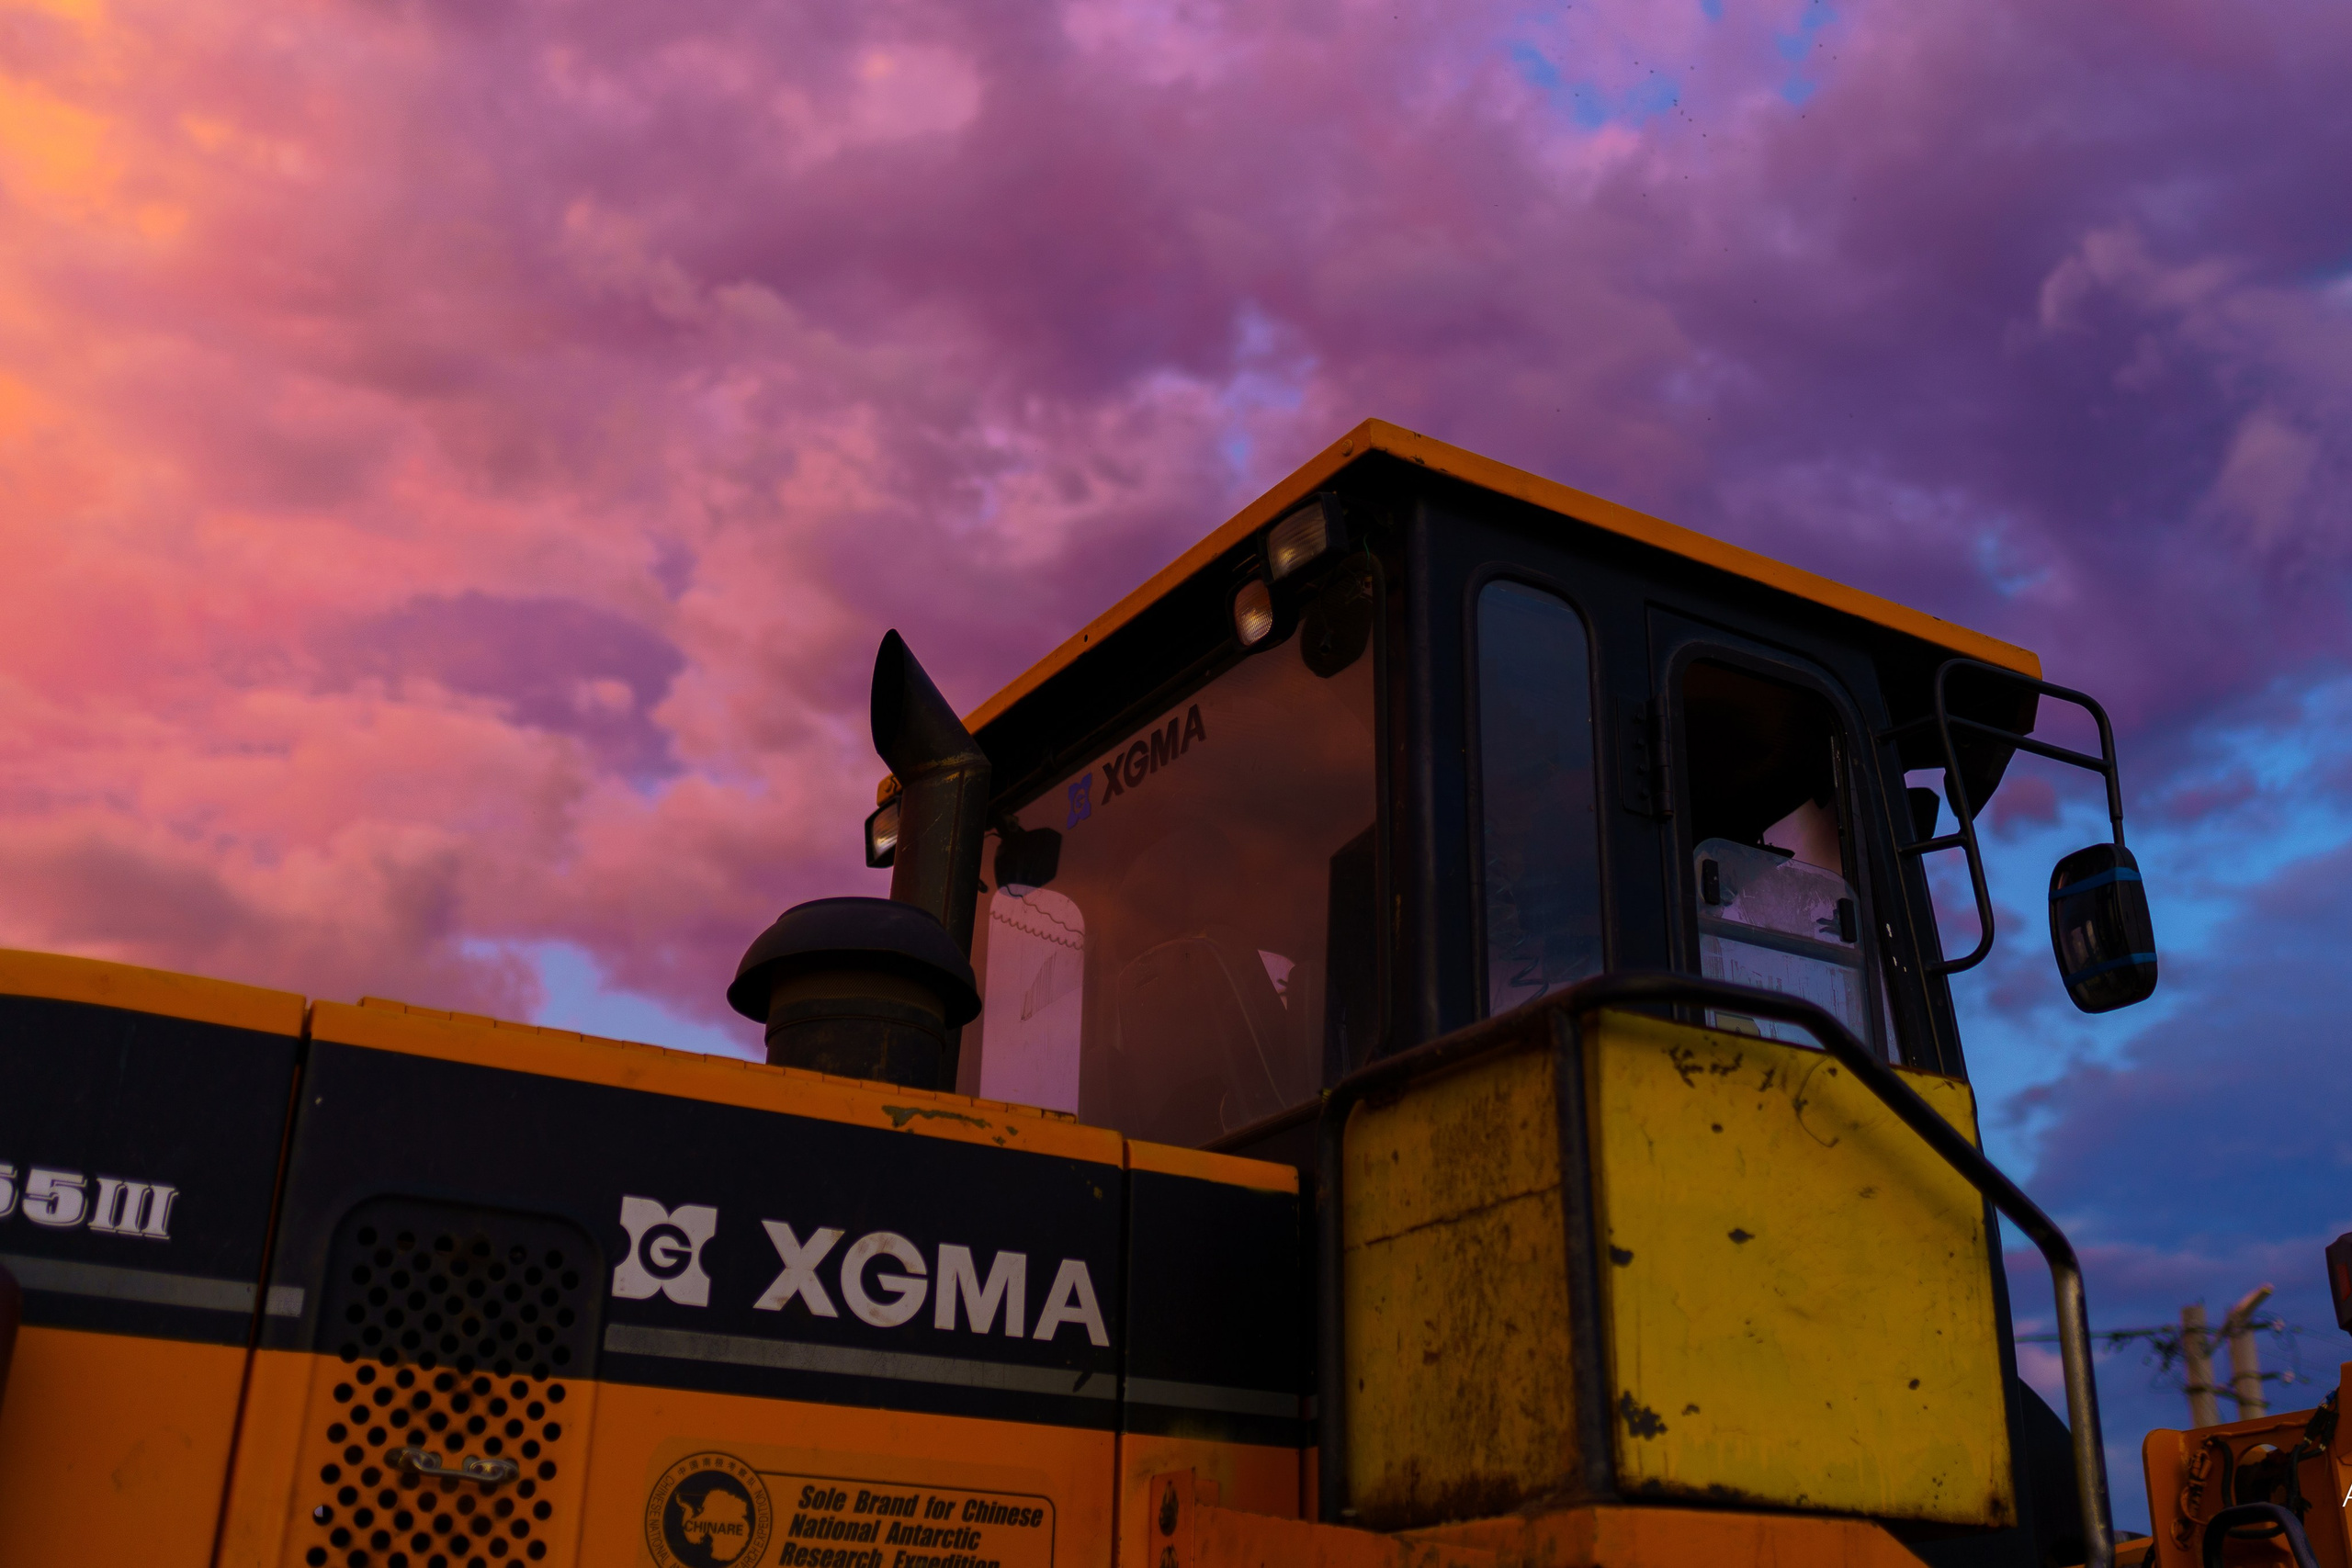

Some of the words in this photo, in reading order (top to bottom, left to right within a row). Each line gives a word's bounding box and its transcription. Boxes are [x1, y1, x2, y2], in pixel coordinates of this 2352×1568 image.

[1102, 704, 1206, 806] XGMA
[0, 1164, 179, 1240] 5III
[752, 1218, 1110, 1348] XGMA
[649, 1475, 675, 1517] CHINESE
[753, 1489, 769, 1549] EXPEDITION
[797, 1484, 847, 1512] Sole
[854, 1490, 919, 1517] Brand
[923, 1496, 956, 1521] for
[961, 1499, 1044, 1529] Chinese
[649, 1518, 671, 1565] NATIONAL
[684, 1519, 743, 1537] CHINARE
[788, 1514, 880, 1543] National
[884, 1521, 981, 1551] Antarctic
[778, 1541, 883, 1568] Research
